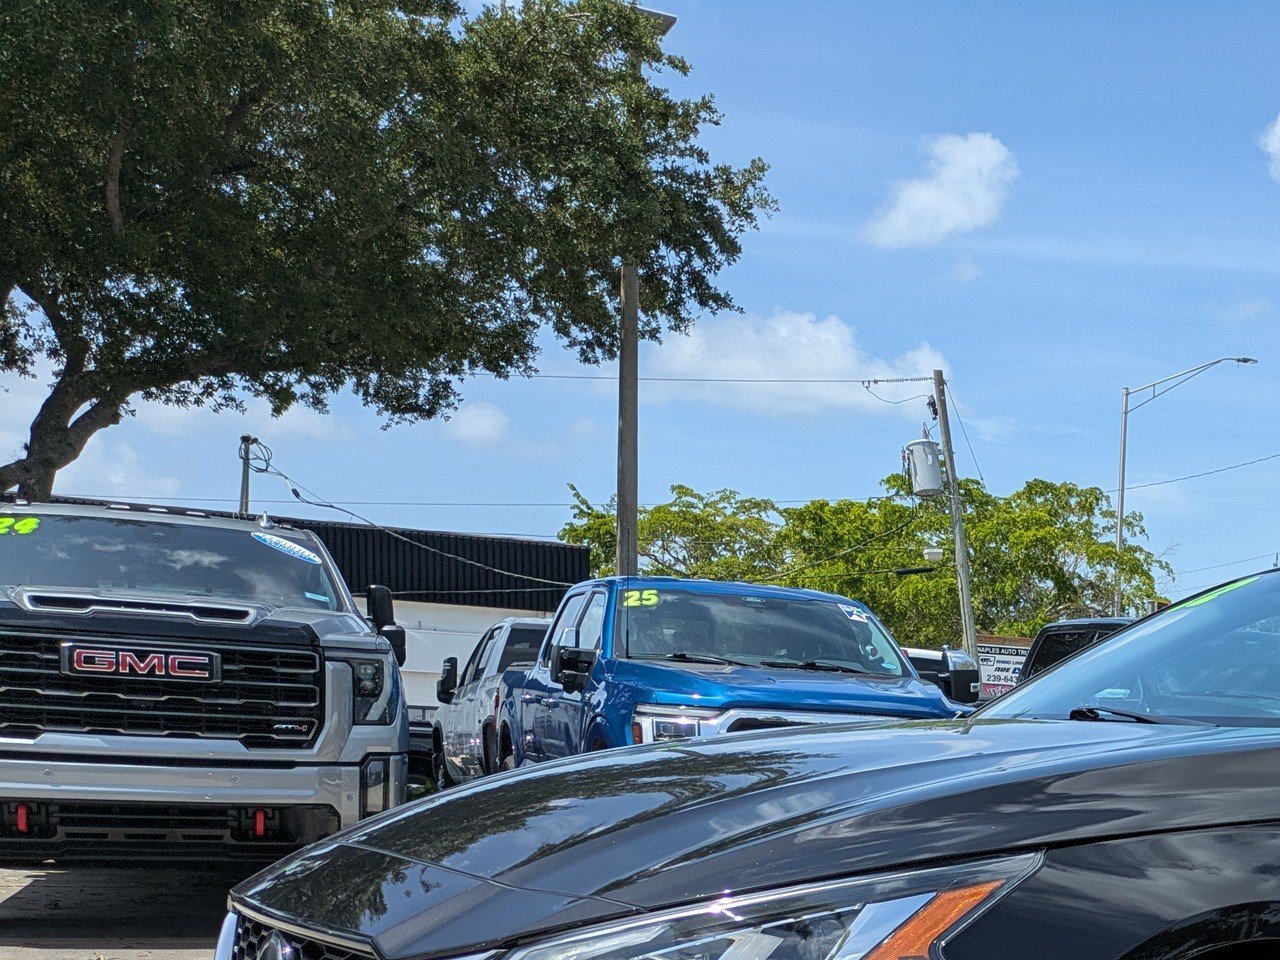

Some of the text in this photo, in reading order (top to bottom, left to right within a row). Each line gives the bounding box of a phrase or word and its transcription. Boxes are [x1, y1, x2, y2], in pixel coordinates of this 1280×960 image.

[623, 590, 660, 607] 25
[977, 646, 1000, 654] NAPLES
[74, 649, 209, 677] GMC
